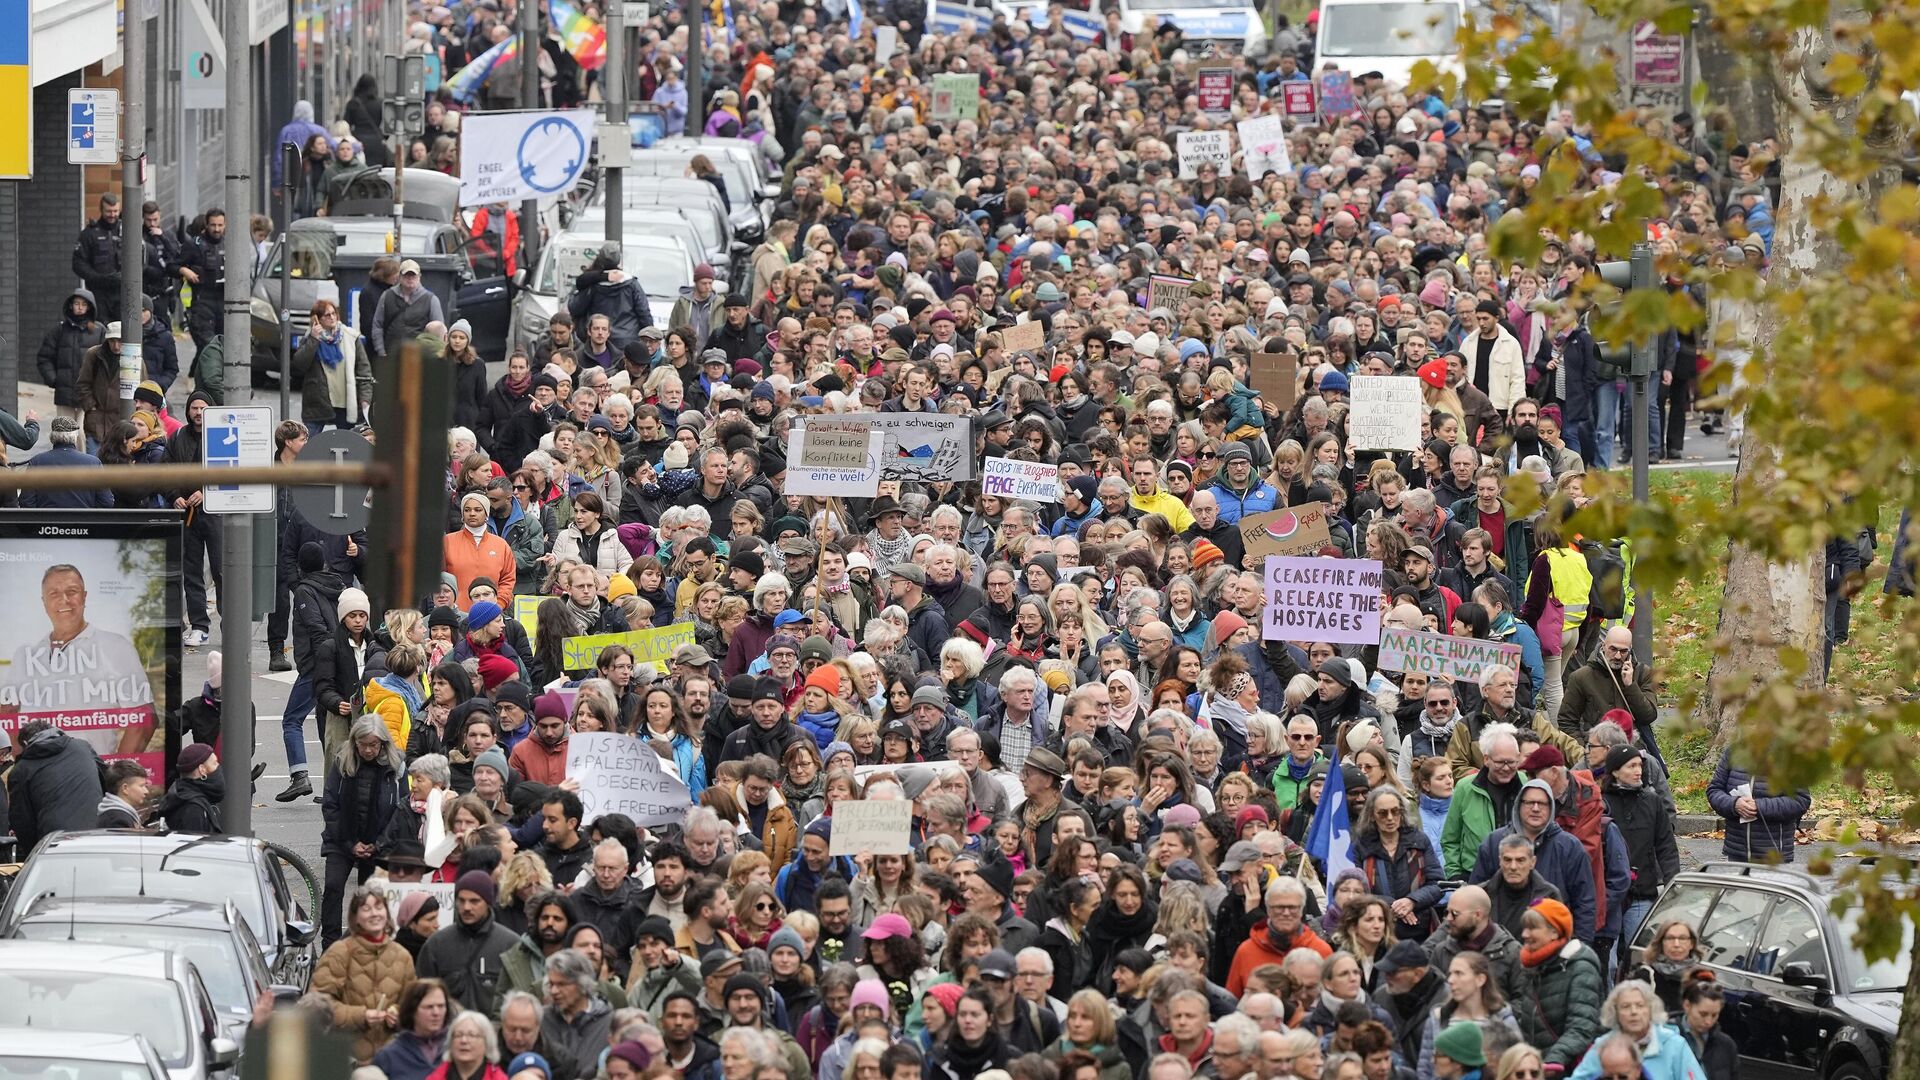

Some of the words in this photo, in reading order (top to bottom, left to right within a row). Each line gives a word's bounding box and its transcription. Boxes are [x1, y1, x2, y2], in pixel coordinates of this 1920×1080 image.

[1185, 133, 1207, 143] WAR
[1211, 132, 1222, 142] IS
[1193, 144, 1219, 152] OVER
[1181, 153, 1209, 161] WHEN
[1211, 153, 1228, 161] YOU
[478, 162, 503, 174] ENGEL
[478, 177, 492, 187] DER
[477, 187, 517, 198] KULTUREN
[1154, 297, 1181, 311] HATRE
[1352, 377, 1382, 389] UNITED
[1370, 403, 1381, 415] WE
[1383, 404, 1403, 415] NEED
[806, 422, 832, 433] Gewalt
[886, 420, 900, 428] zu
[905, 417, 954, 431] schweigen
[812, 435, 835, 447] lösen
[838, 436, 863, 448] keine
[1359, 436, 1393, 449] PEACE
[804, 451, 862, 465] Konflikte!
[985, 460, 1012, 474] STOPS
[811, 471, 836, 481] eine
[840, 471, 865, 482] welt
[984, 474, 1015, 494] PEACE
[1016, 478, 1056, 498] EVERYWHERE
[38, 526, 89, 535] JCDecaux
[1243, 523, 1267, 544] FREE
[1300, 510, 1322, 529] GAZA
[1280, 547, 1294, 557] THE
[1297, 538, 1329, 552] MASSACRE
[0, 551, 26, 562] Stadt
[28, 551, 53, 562] Köln
[1358, 571, 1382, 589] NOW
[1274, 589, 1344, 609] RELEASE
[1349, 593, 1378, 612] THE
[1272, 609, 1363, 631] HOSTAGES
[1382, 632, 1446, 656] MAKE
[1448, 640, 1521, 671] HUMMUS
[1402, 654, 1450, 674] NOT
[1453, 661, 1482, 678] WA
[0, 717, 14, 729] m
[584, 755, 661, 775] PALESTINI
[596, 774, 670, 793] DESERVE
[618, 799, 687, 816] FREEDOM
[834, 802, 897, 818] FREEDOM
